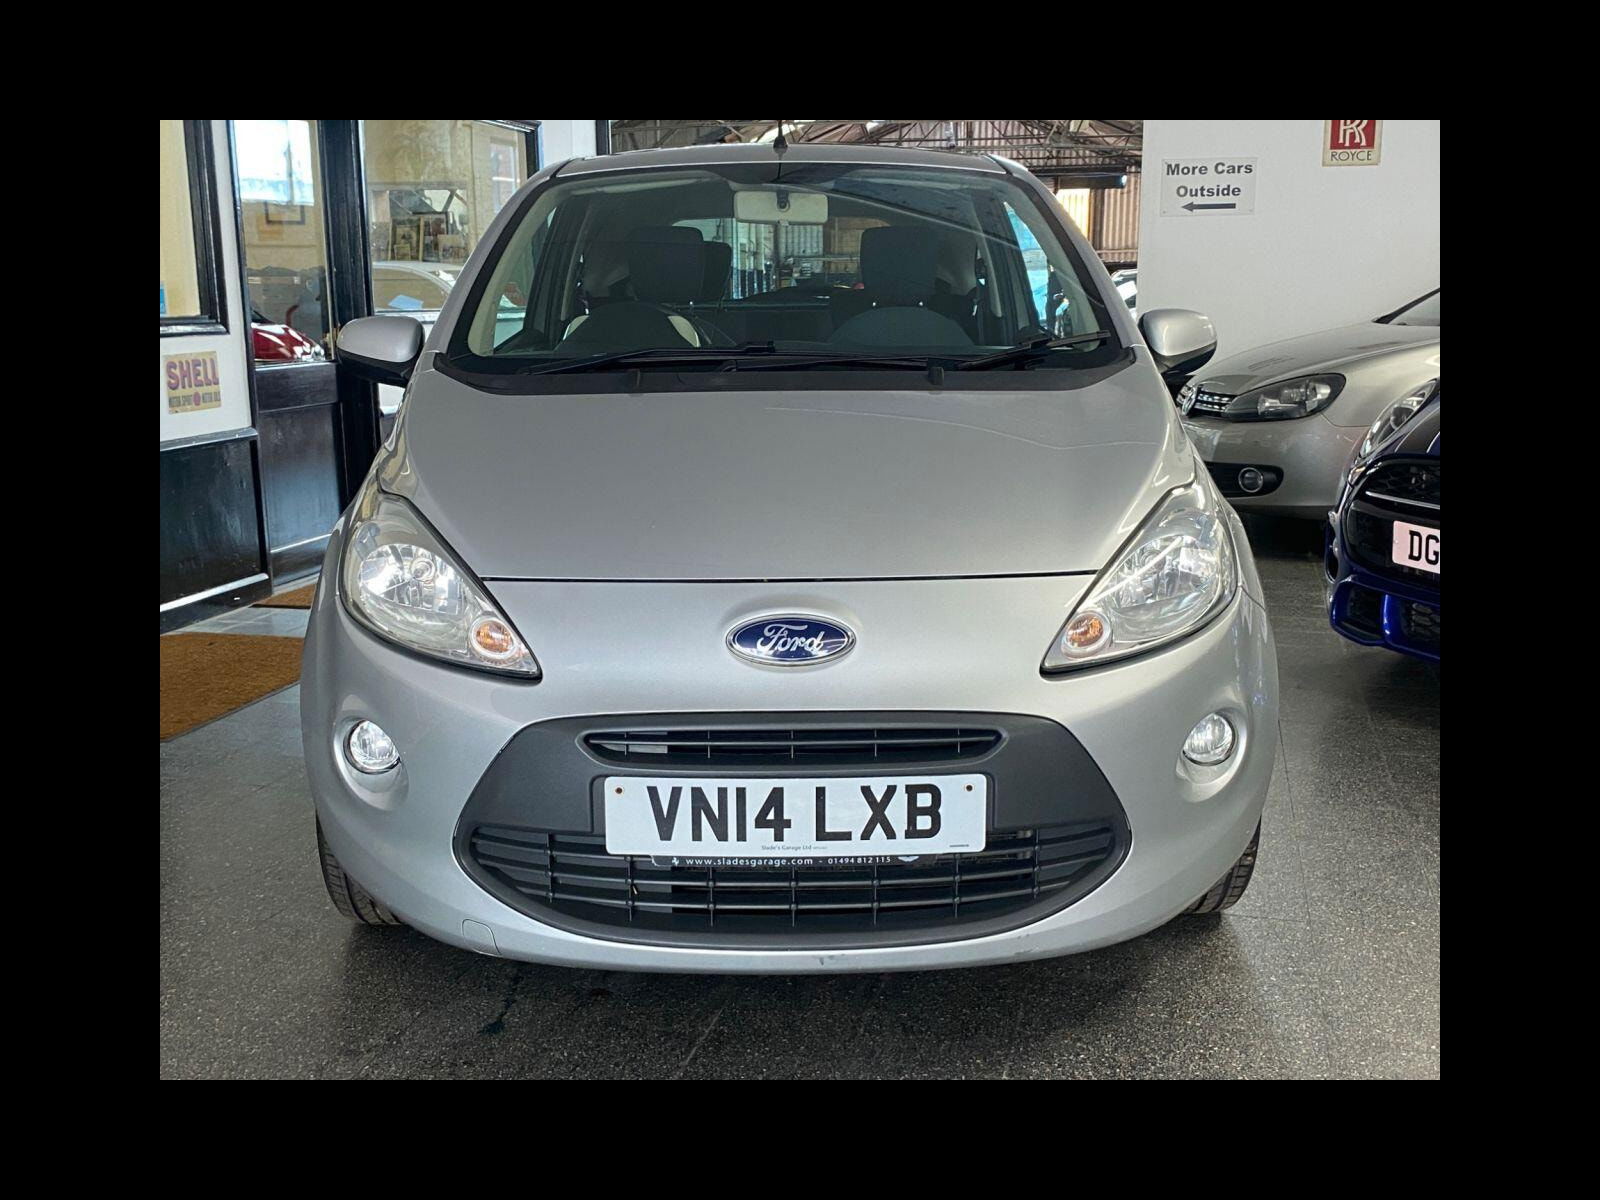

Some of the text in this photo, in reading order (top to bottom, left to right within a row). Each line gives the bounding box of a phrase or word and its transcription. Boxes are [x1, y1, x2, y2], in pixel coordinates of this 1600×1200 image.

[1330, 151, 1372, 161] ROYCE
[1166, 162, 1253, 176] More Cars
[1176, 184, 1241, 198] Outside
[166, 358, 219, 390] SHELL
[756, 623, 826, 653] Ford
[646, 783, 942, 842] VN14 LXB
[685, 857, 813, 867] www.sladesgarage.com
